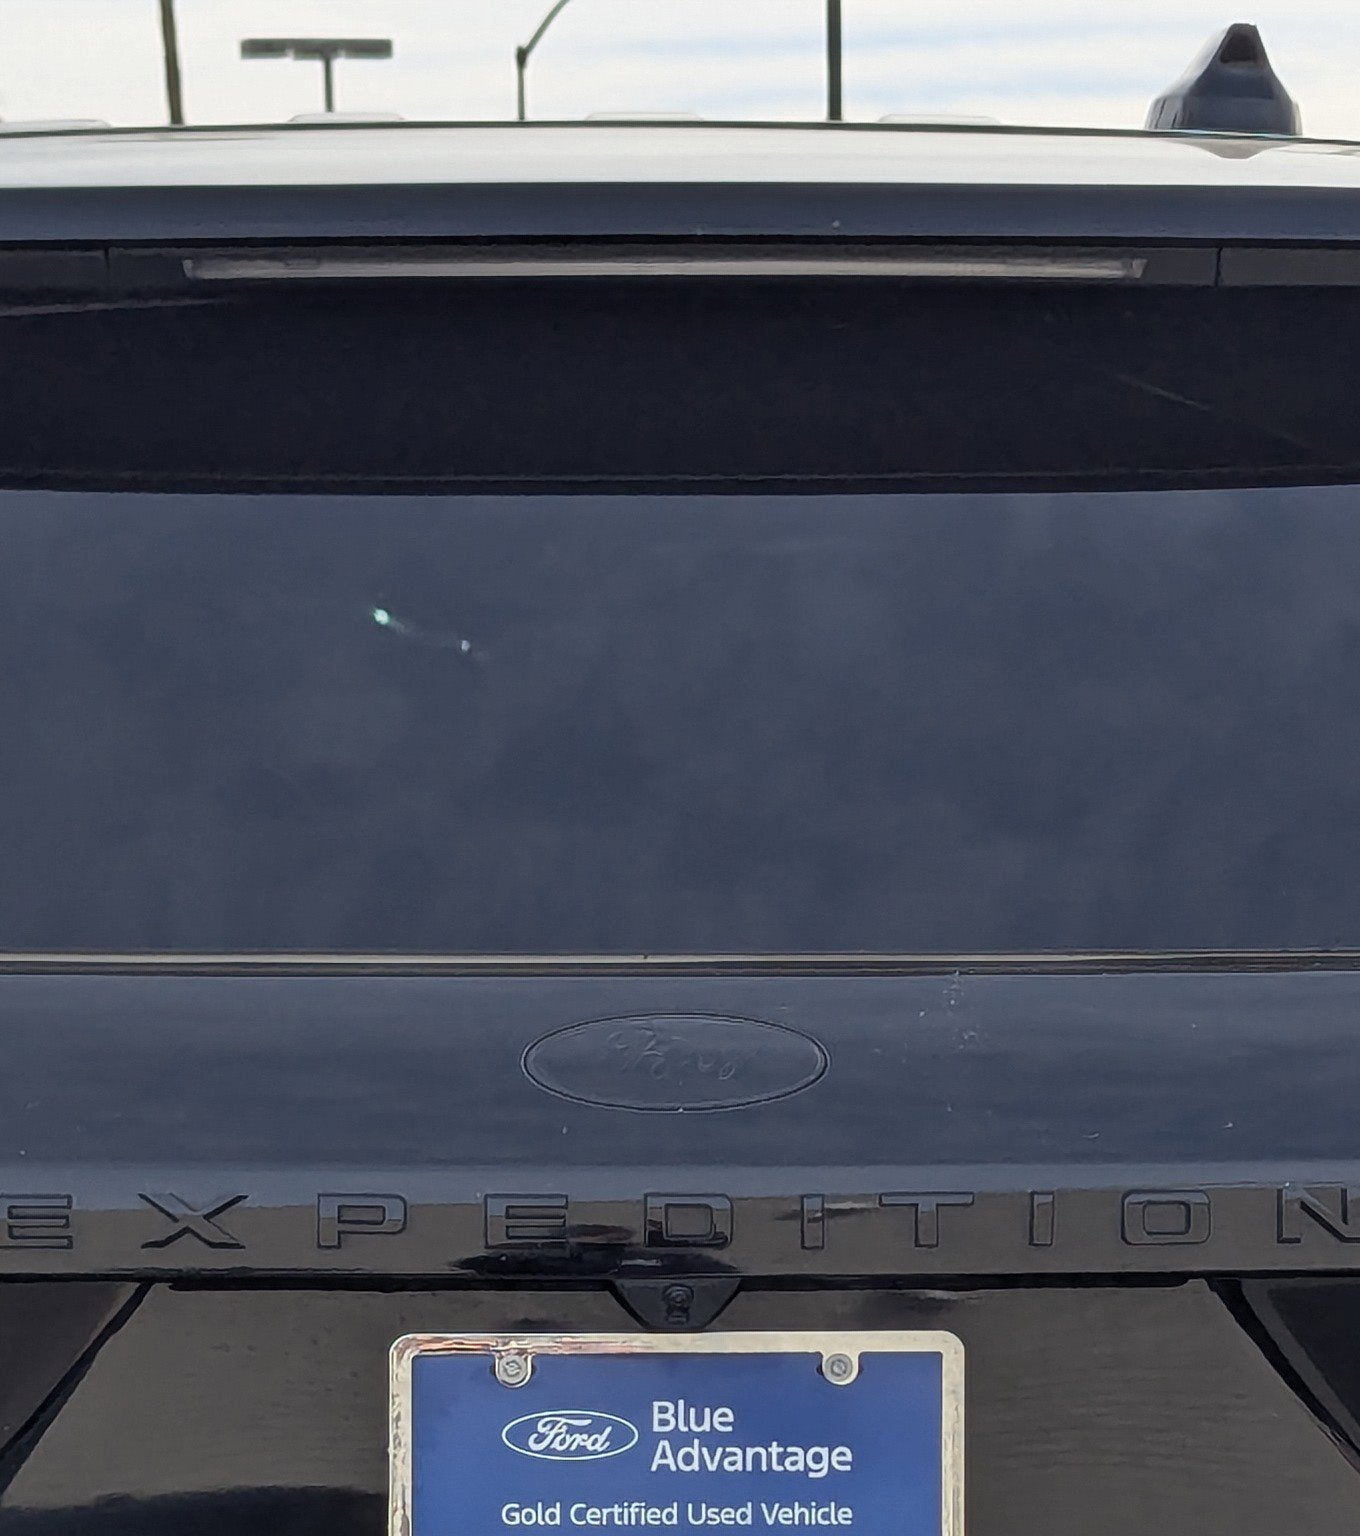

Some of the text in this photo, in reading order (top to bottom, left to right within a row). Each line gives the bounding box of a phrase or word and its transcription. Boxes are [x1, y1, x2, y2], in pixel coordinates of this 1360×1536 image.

[527, 1415, 612, 1454] Ford
[651, 1400, 735, 1433] Blue
[650, 1439, 853, 1478] Advantage
[501, 1500, 853, 1526] Gold Certified Used Vehicle
